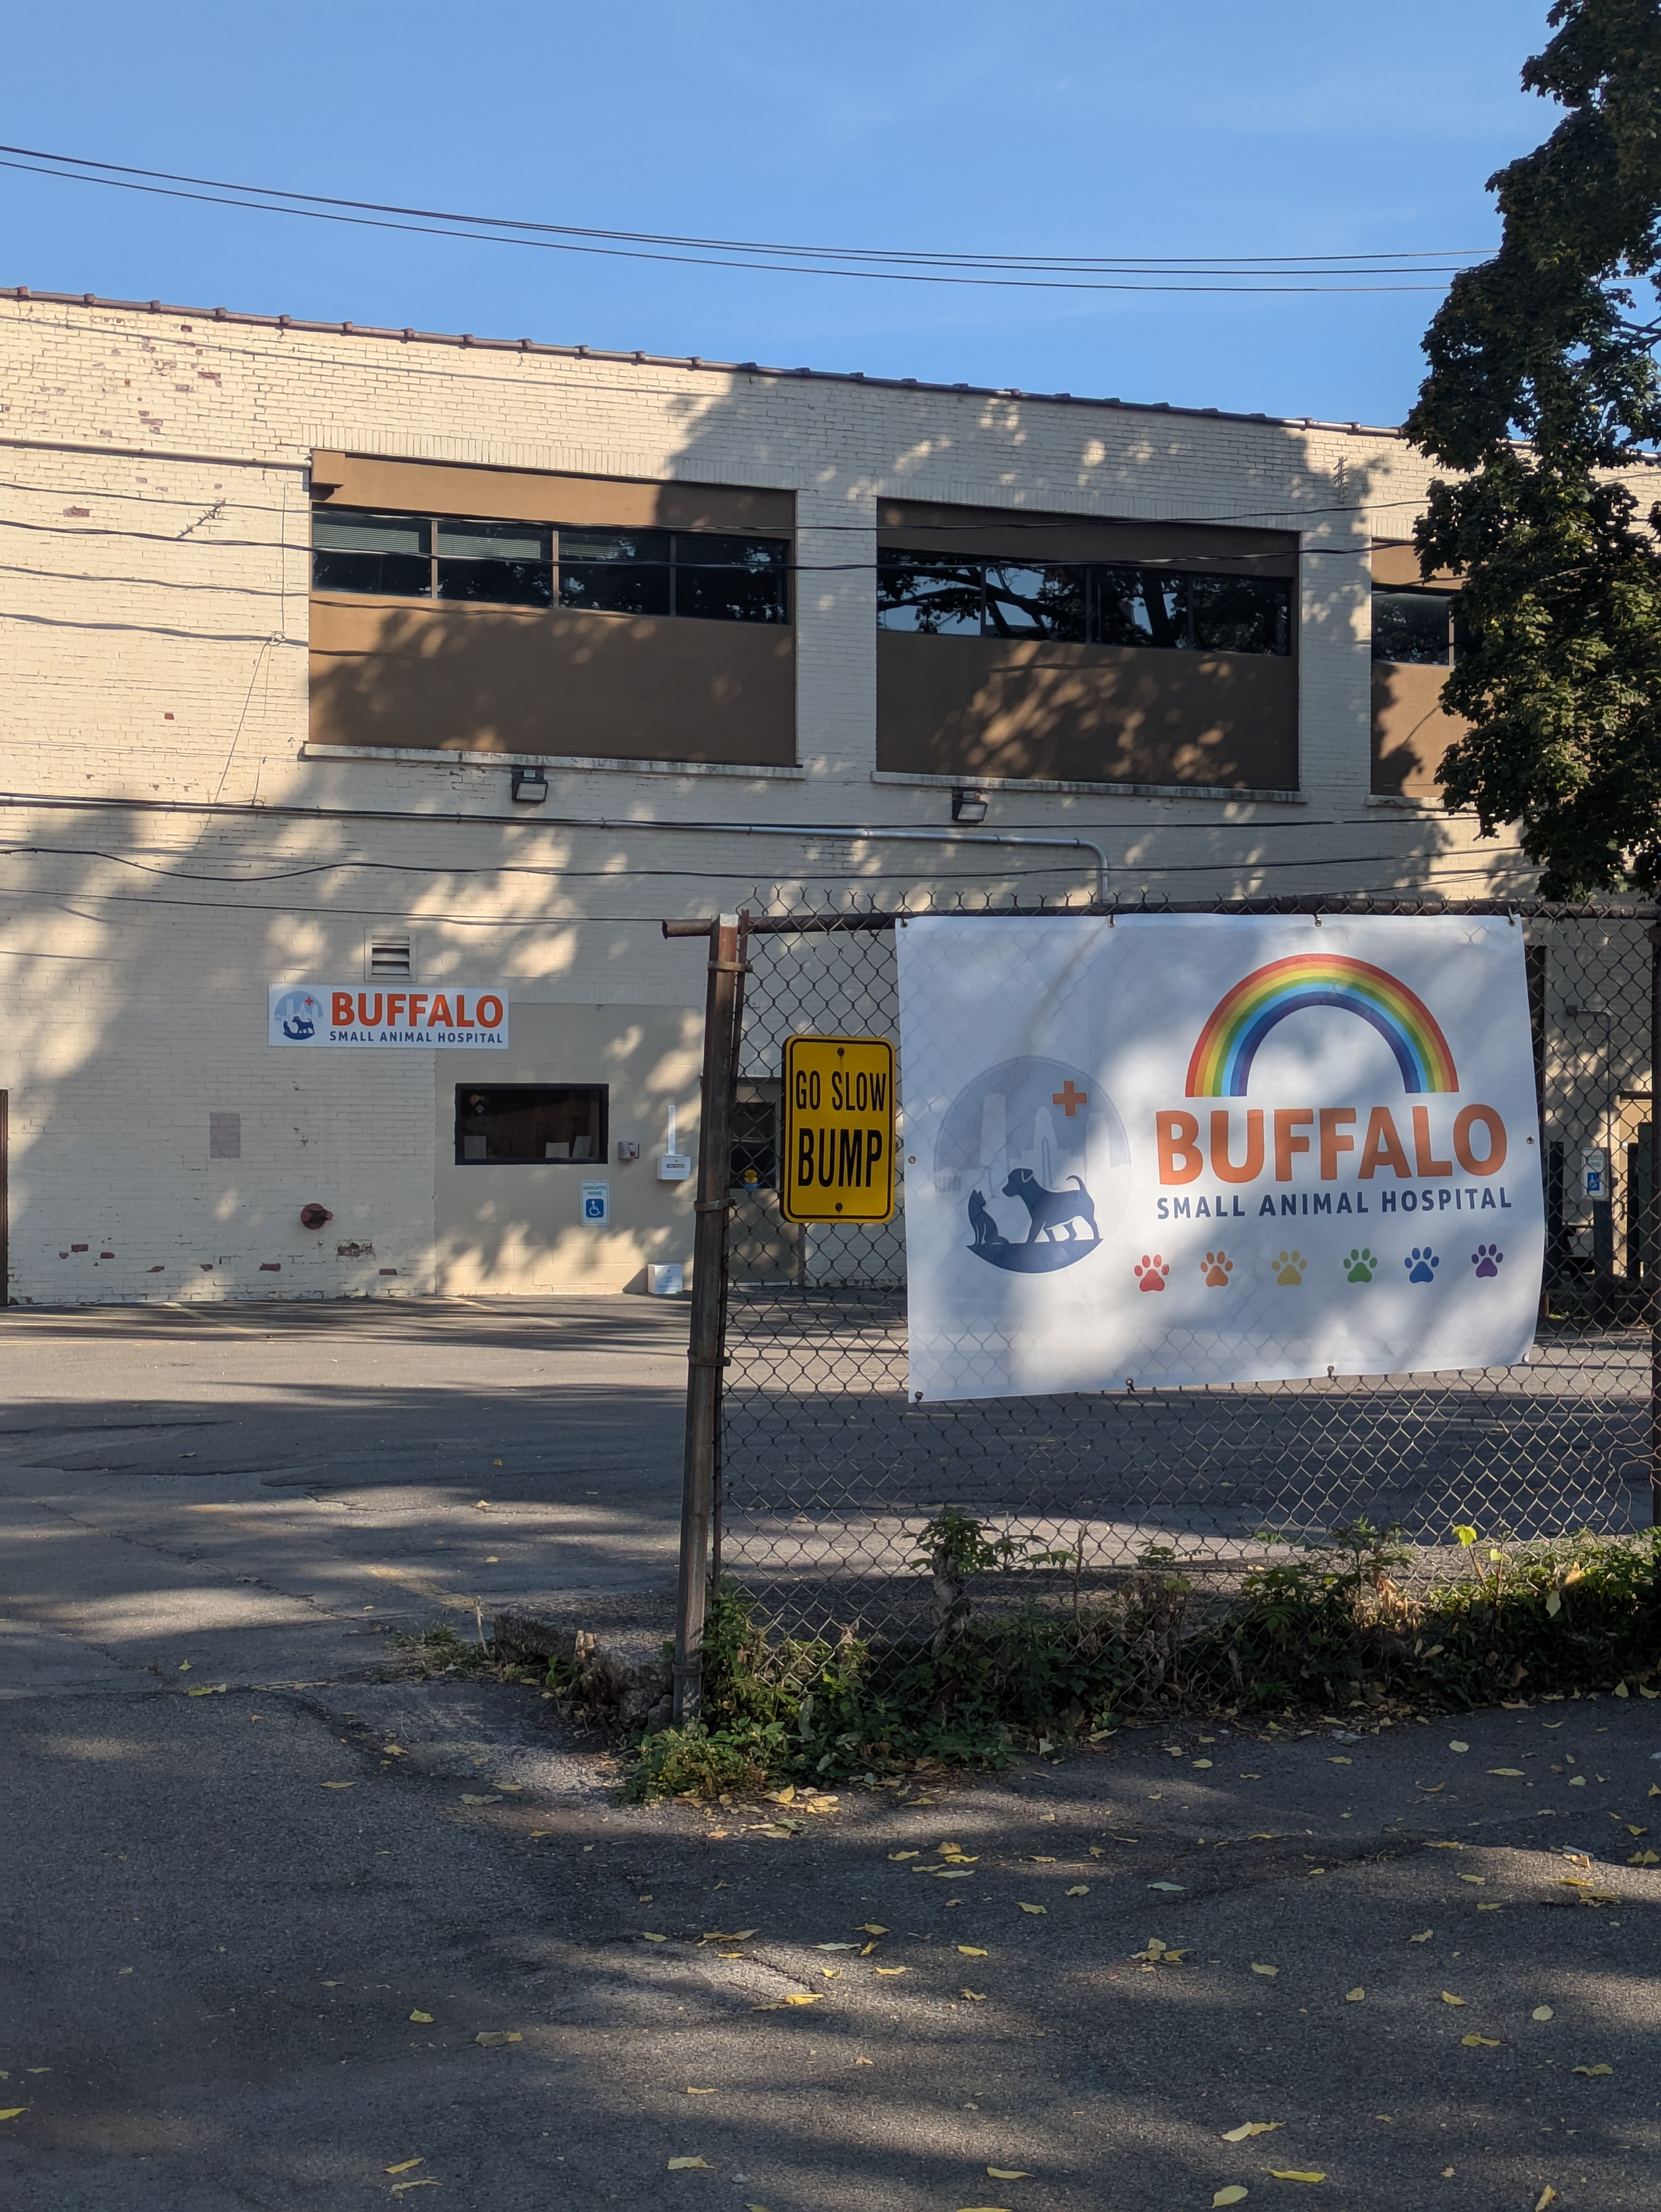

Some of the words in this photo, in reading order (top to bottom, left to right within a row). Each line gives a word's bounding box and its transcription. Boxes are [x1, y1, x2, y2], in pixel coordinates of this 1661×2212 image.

[332, 992, 503, 1028] BUFFALO
[330, 1030, 374, 1041] SMALL
[379, 1031, 432, 1042] ANIMAL
[438, 1032, 503, 1043] HOSPITAL
[796, 1070, 821, 1110] GO
[831, 1071, 886, 1112] SLOW
[797, 1128, 883, 1187] BUMP
[1155, 1104, 1507, 1185] BUFFALO
[1157, 1194, 1245, 1219] SMALL
[1258, 1191, 1369, 1217] ANIMAL
[1381, 1187, 1512, 1213] HOSPITAL
